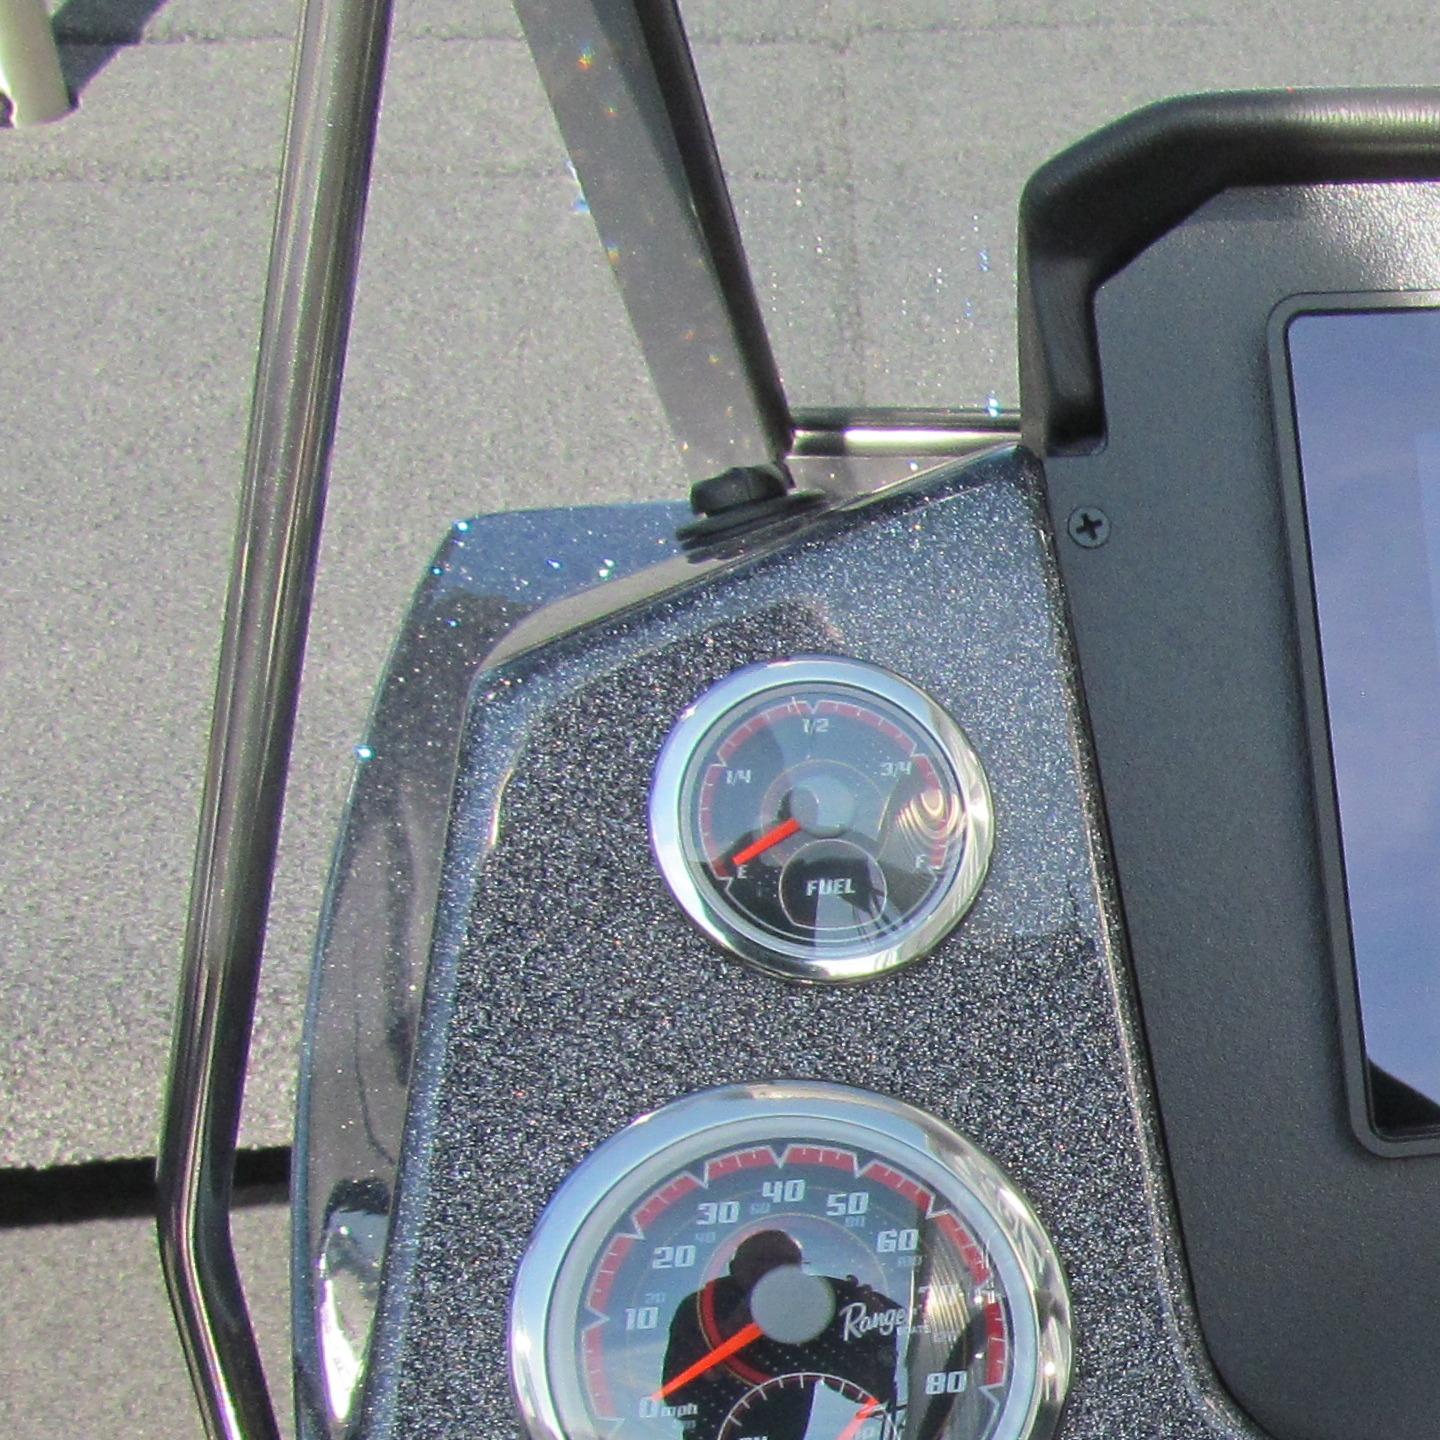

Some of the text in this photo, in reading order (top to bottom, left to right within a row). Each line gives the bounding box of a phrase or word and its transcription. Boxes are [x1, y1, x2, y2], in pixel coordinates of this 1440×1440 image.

[802, 719, 829, 734] 1/2
[726, 769, 752, 785] 1/4
[880, 762, 912, 777] 3/4
[737, 866, 748, 879] E
[806, 878, 857, 897] FUEL
[762, 1179, 806, 1203] 40
[695, 1200, 741, 1225] 30
[826, 1192, 869, 1216] 50
[876, 1228, 919, 1252] 60
[651, 1245, 696, 1269] 20
[624, 1306, 659, 1331] 10
[925, 1369, 968, 1395] 80
[661, 1402, 698, 1418] mph
